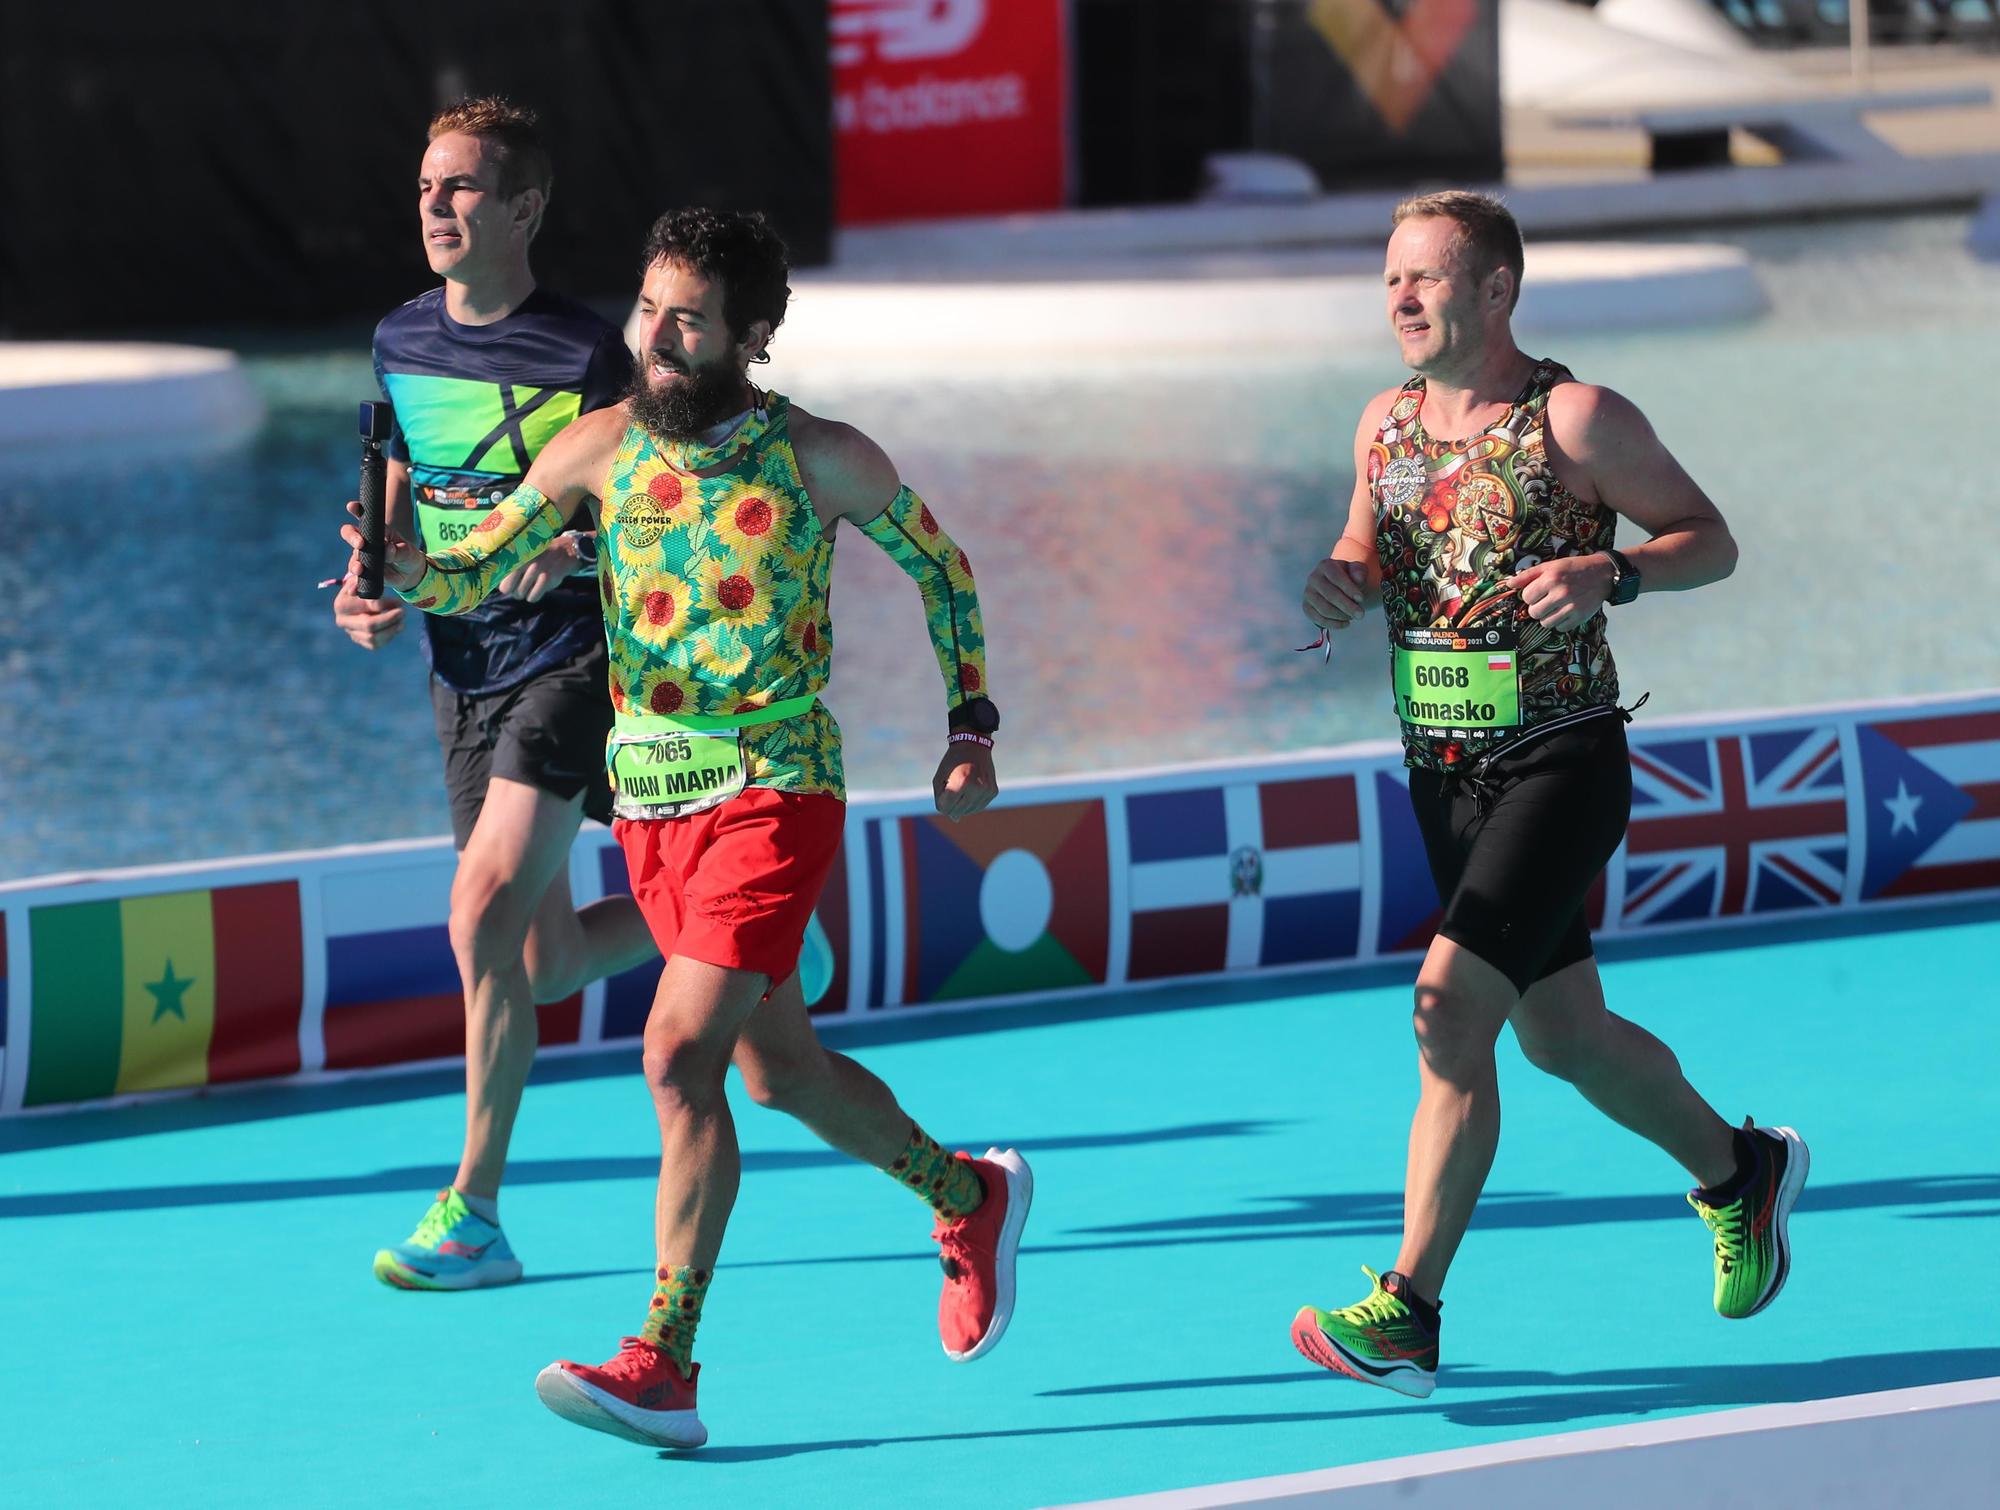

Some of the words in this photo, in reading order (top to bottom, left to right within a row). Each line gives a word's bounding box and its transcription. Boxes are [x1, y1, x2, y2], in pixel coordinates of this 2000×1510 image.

[862, 72, 1025, 133] balance
[641, 516, 672, 525] POWER
[1432, 631, 1460, 639] VALENCIA
[1415, 665, 1469, 688] 6068
[1403, 695, 1496, 721] Tomasko
[646, 739, 692, 766] 7065
[978, 736, 992, 747] RUN
[665, 765, 739, 795] MARIA
